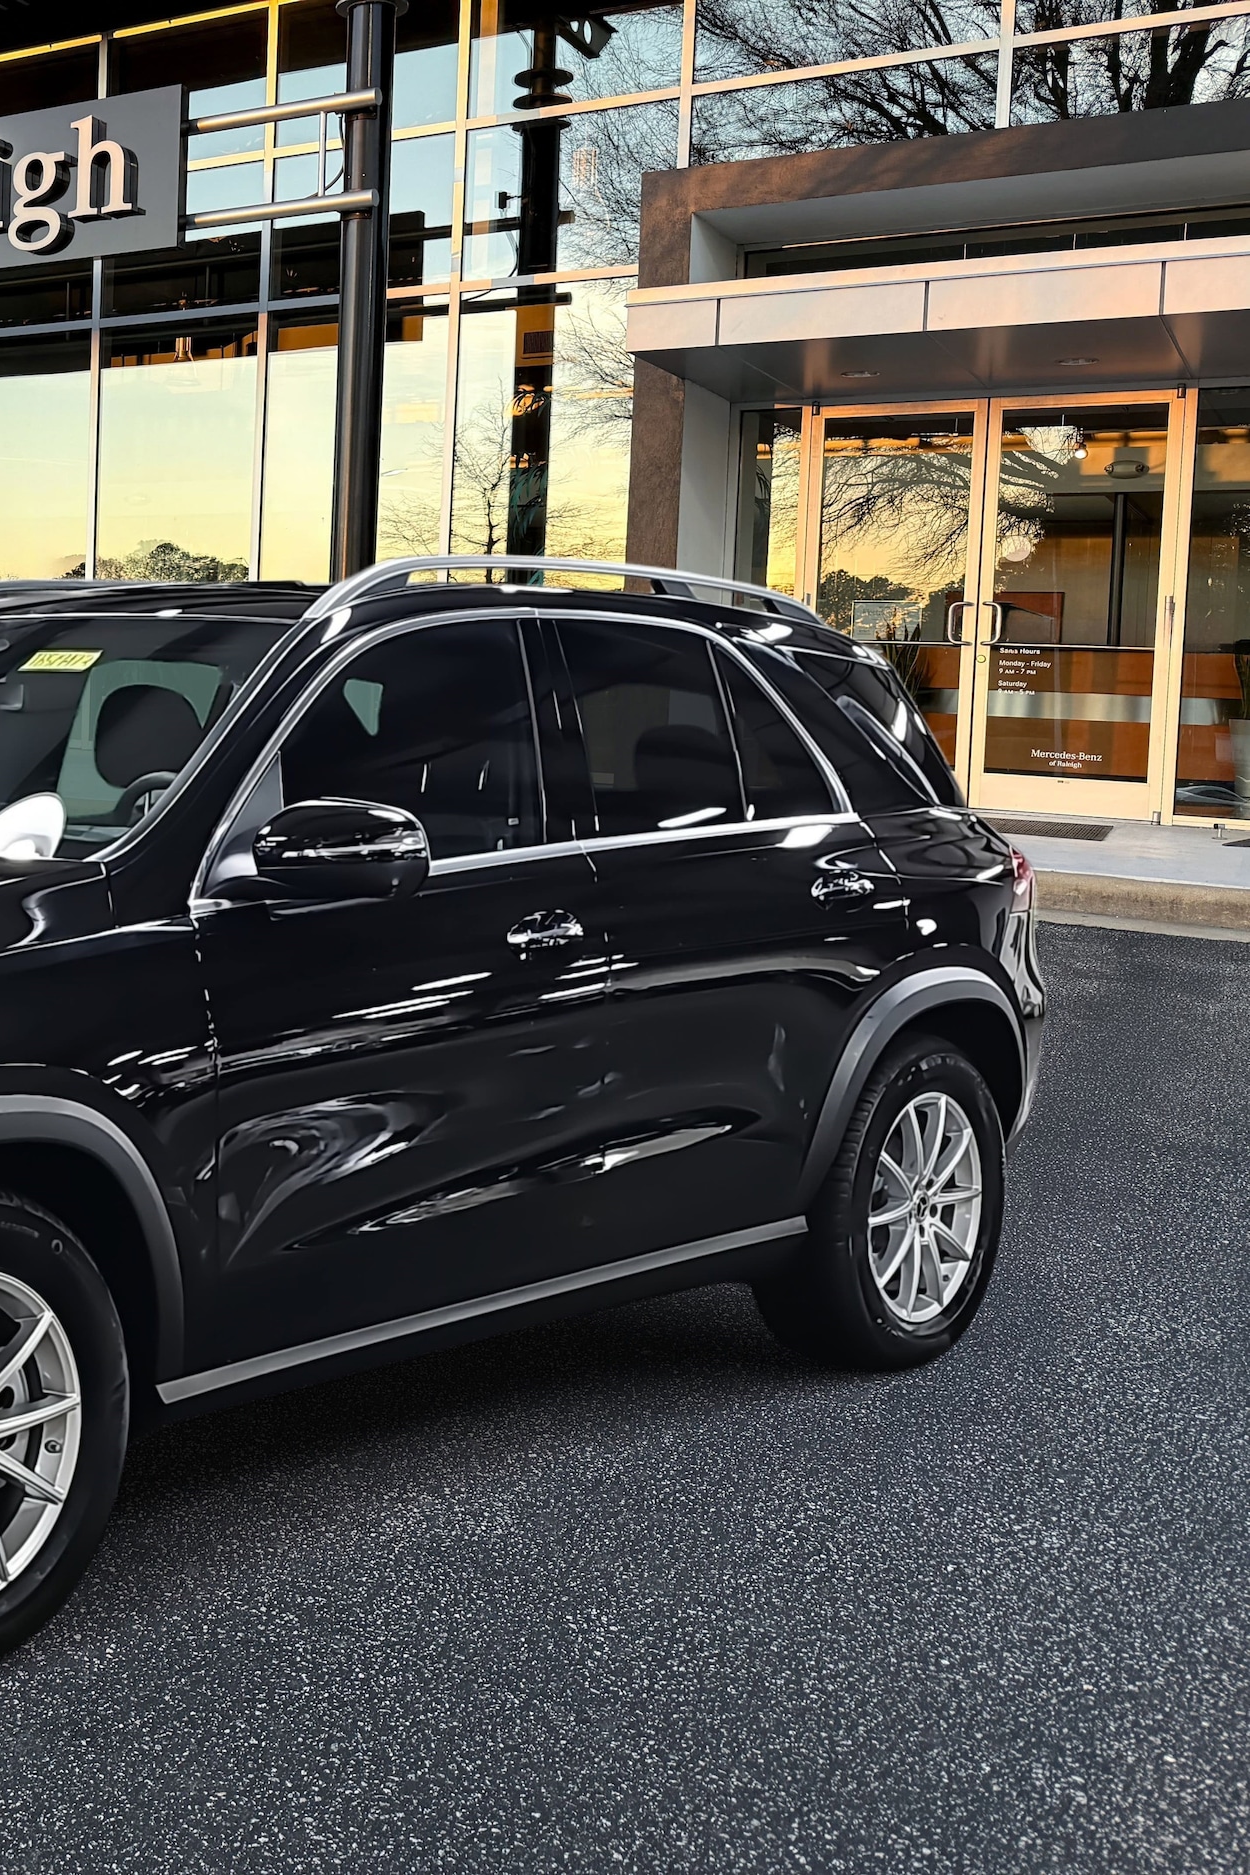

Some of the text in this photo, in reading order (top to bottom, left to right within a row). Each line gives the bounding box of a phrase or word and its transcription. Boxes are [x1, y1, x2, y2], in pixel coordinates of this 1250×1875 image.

[999, 660, 1025, 668] Monday
[1030, 660, 1052, 668] Friday
[997, 680, 1028, 688] Saturday
[1030, 748, 1103, 762] Mercedes-Benz
[1057, 761, 1082, 769] Raleigh
